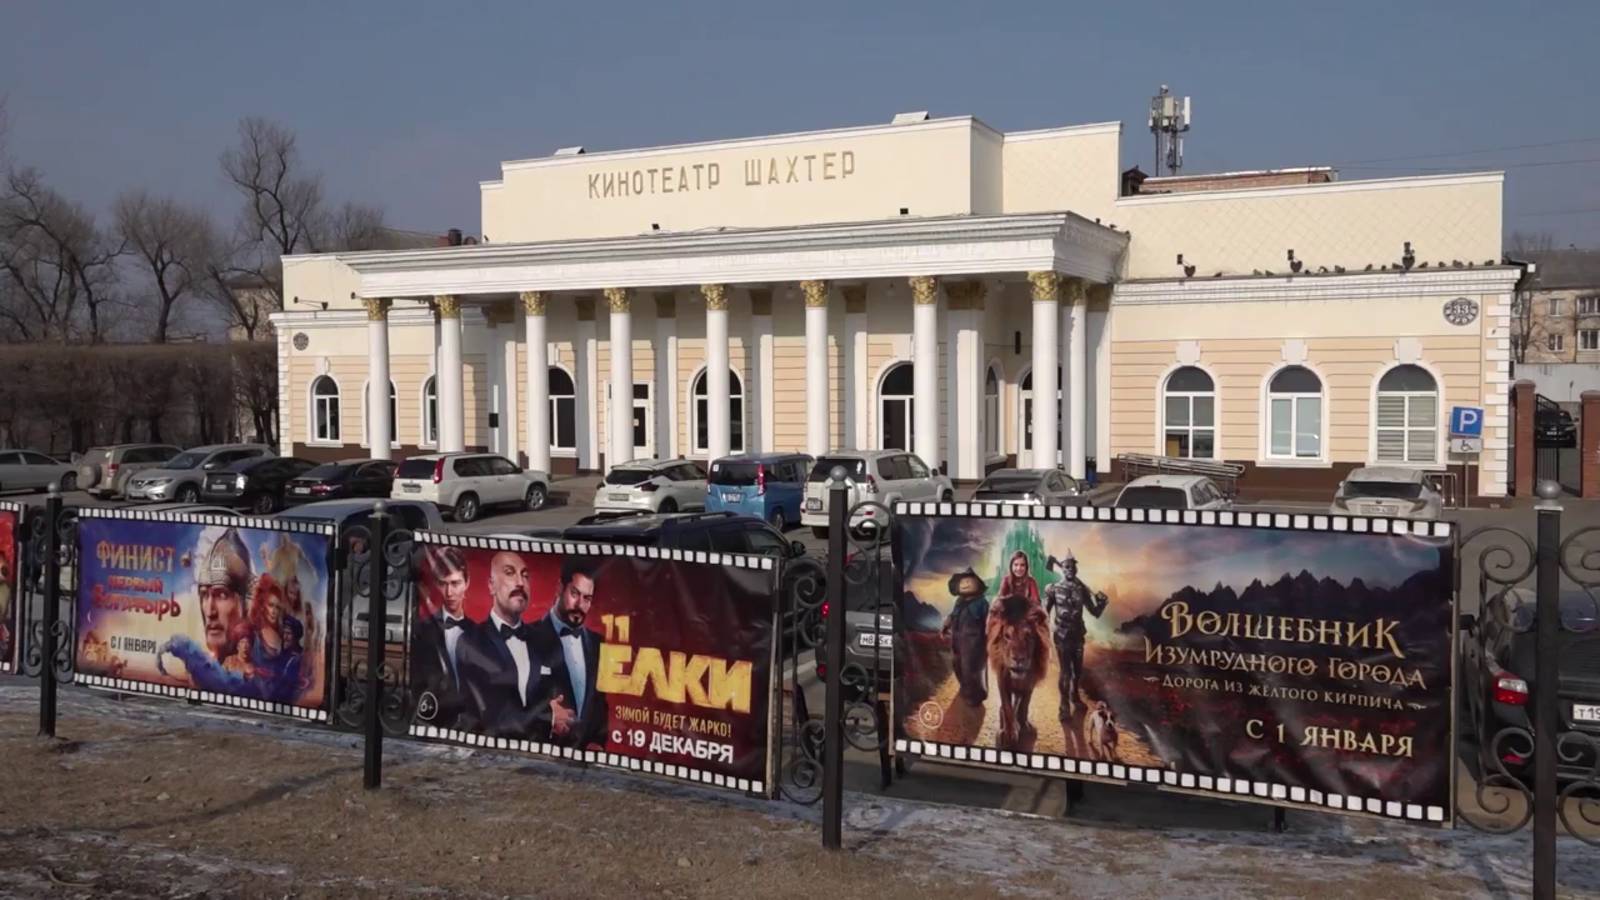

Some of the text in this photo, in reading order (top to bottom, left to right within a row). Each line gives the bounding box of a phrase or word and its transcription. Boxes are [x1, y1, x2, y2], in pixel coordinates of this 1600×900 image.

[588, 151, 855, 199] КИНОТЕАТР ШАХТЕР
[1460, 410, 1477, 432] P
[96, 541, 176, 572] ФИНИСТ
[601, 614, 631, 644] 11
[420, 699, 433, 712] 6+
[1162, 674, 1219, 690] ДОРОГА
[1224, 680, 1243, 693] ИЗ
[1324, 691, 1404, 711] КИРПИЧА
[615, 705, 732, 737] ЗИМОЙ БУДЕТ ЖАРКО!
[626, 729, 646, 748] 19
[649, 732, 734, 764] ДЕКАБРЯ
[1277, 725, 1286, 744] 1
[1300, 726, 1414, 759] ЯНВАРЯ
